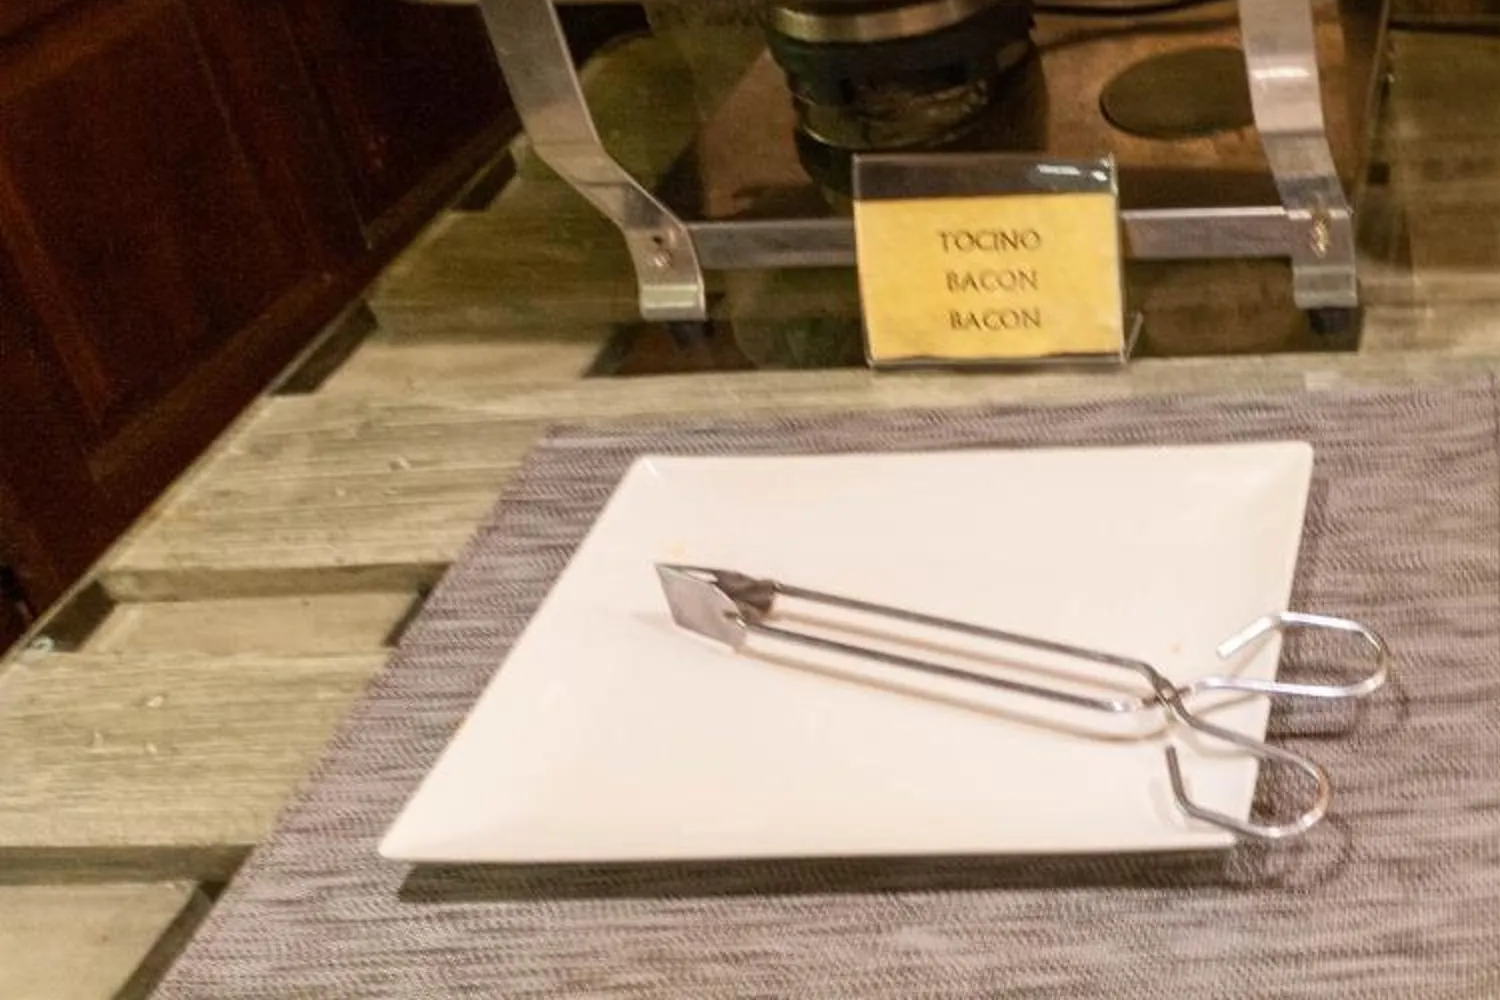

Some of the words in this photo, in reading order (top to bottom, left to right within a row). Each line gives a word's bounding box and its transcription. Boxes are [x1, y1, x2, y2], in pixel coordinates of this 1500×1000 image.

[936, 228, 1042, 253] TOCINO
[945, 269, 1039, 293] BACON
[949, 306, 1042, 331] BACON
